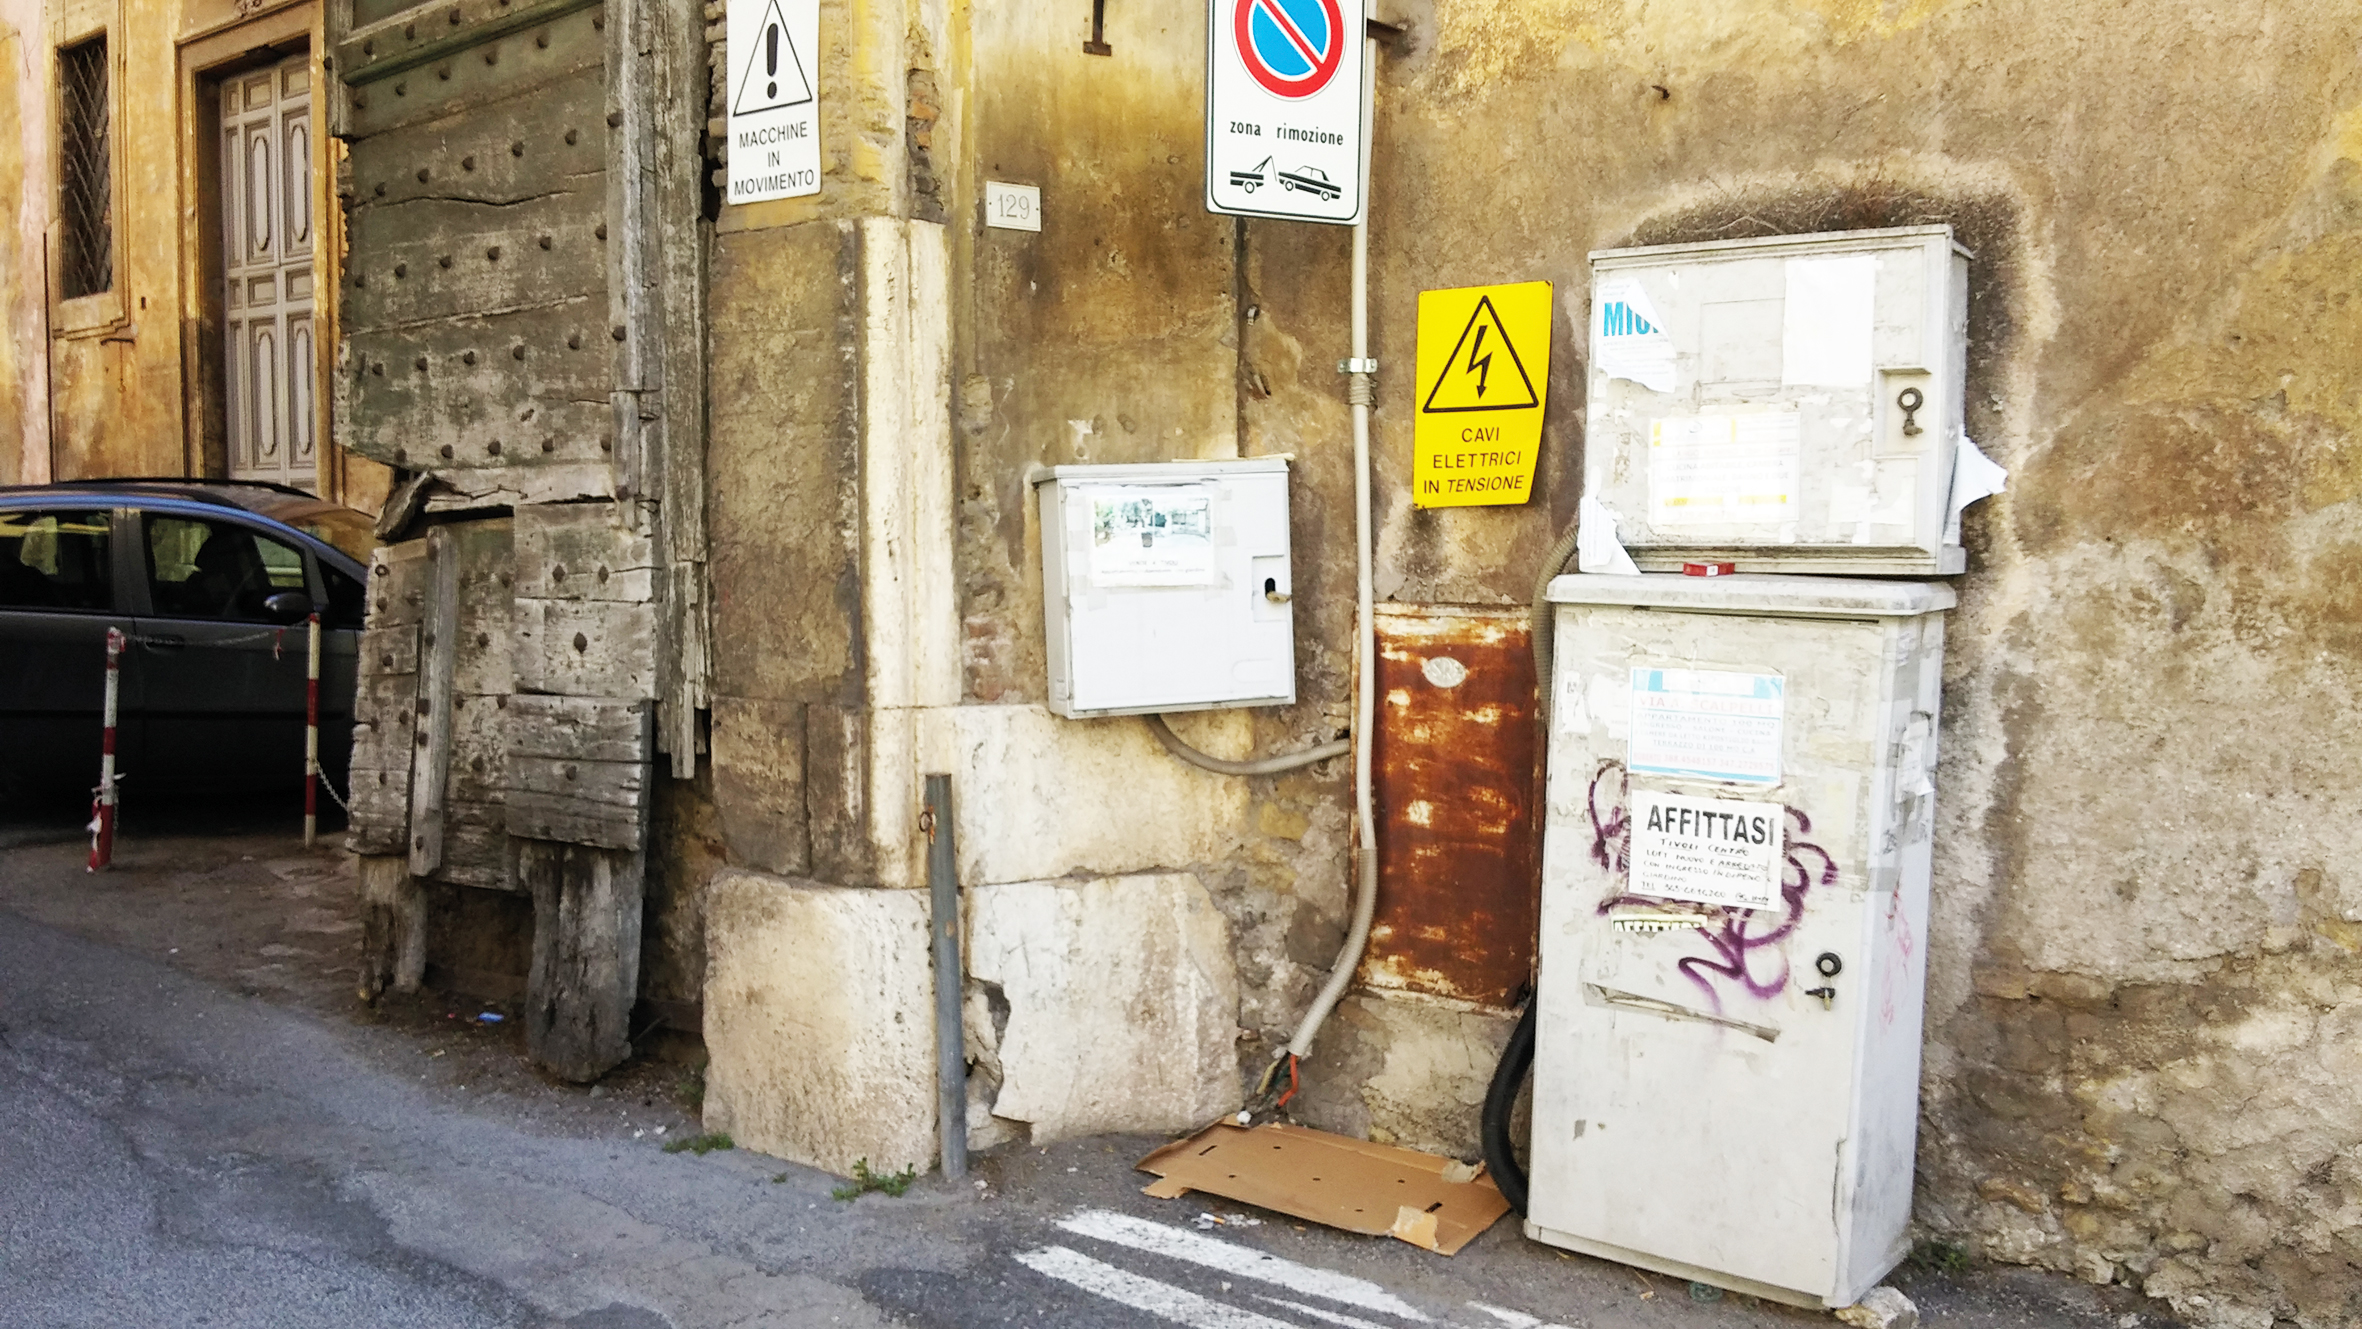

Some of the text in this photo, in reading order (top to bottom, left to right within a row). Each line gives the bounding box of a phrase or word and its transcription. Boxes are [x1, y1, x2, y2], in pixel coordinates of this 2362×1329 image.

[739, 121, 808, 148] MACCHINE
[1230, 121, 1344, 146] zona rimozione
[767, 150, 780, 167] IN
[734, 169, 814, 196] MOVIMENTO
[997, 193, 1030, 220] 129
[1461, 427, 1500, 443] CAVI
[1433, 451, 1521, 469] ELETTRICI
[1423, 475, 1525, 494] IN TENSIONE
[1639, 697, 1665, 707] VIA
[1690, 698, 1774, 715] SCALPELLI
[1636, 711, 1728, 726] APPARTAMENTO
[1731, 719, 1753, 727] 100
[1757, 720, 1776, 730] MQ
[1639, 721, 1772, 737] INGRESSO SALONE CUCINA
[1653, 738, 1694, 749] TERRAZZO
[1646, 804, 1776, 847] AFFITTASI
[1646, 849, 1668, 858] LOFT
[1659, 837, 1750, 857] TIVOLI CENTRO
